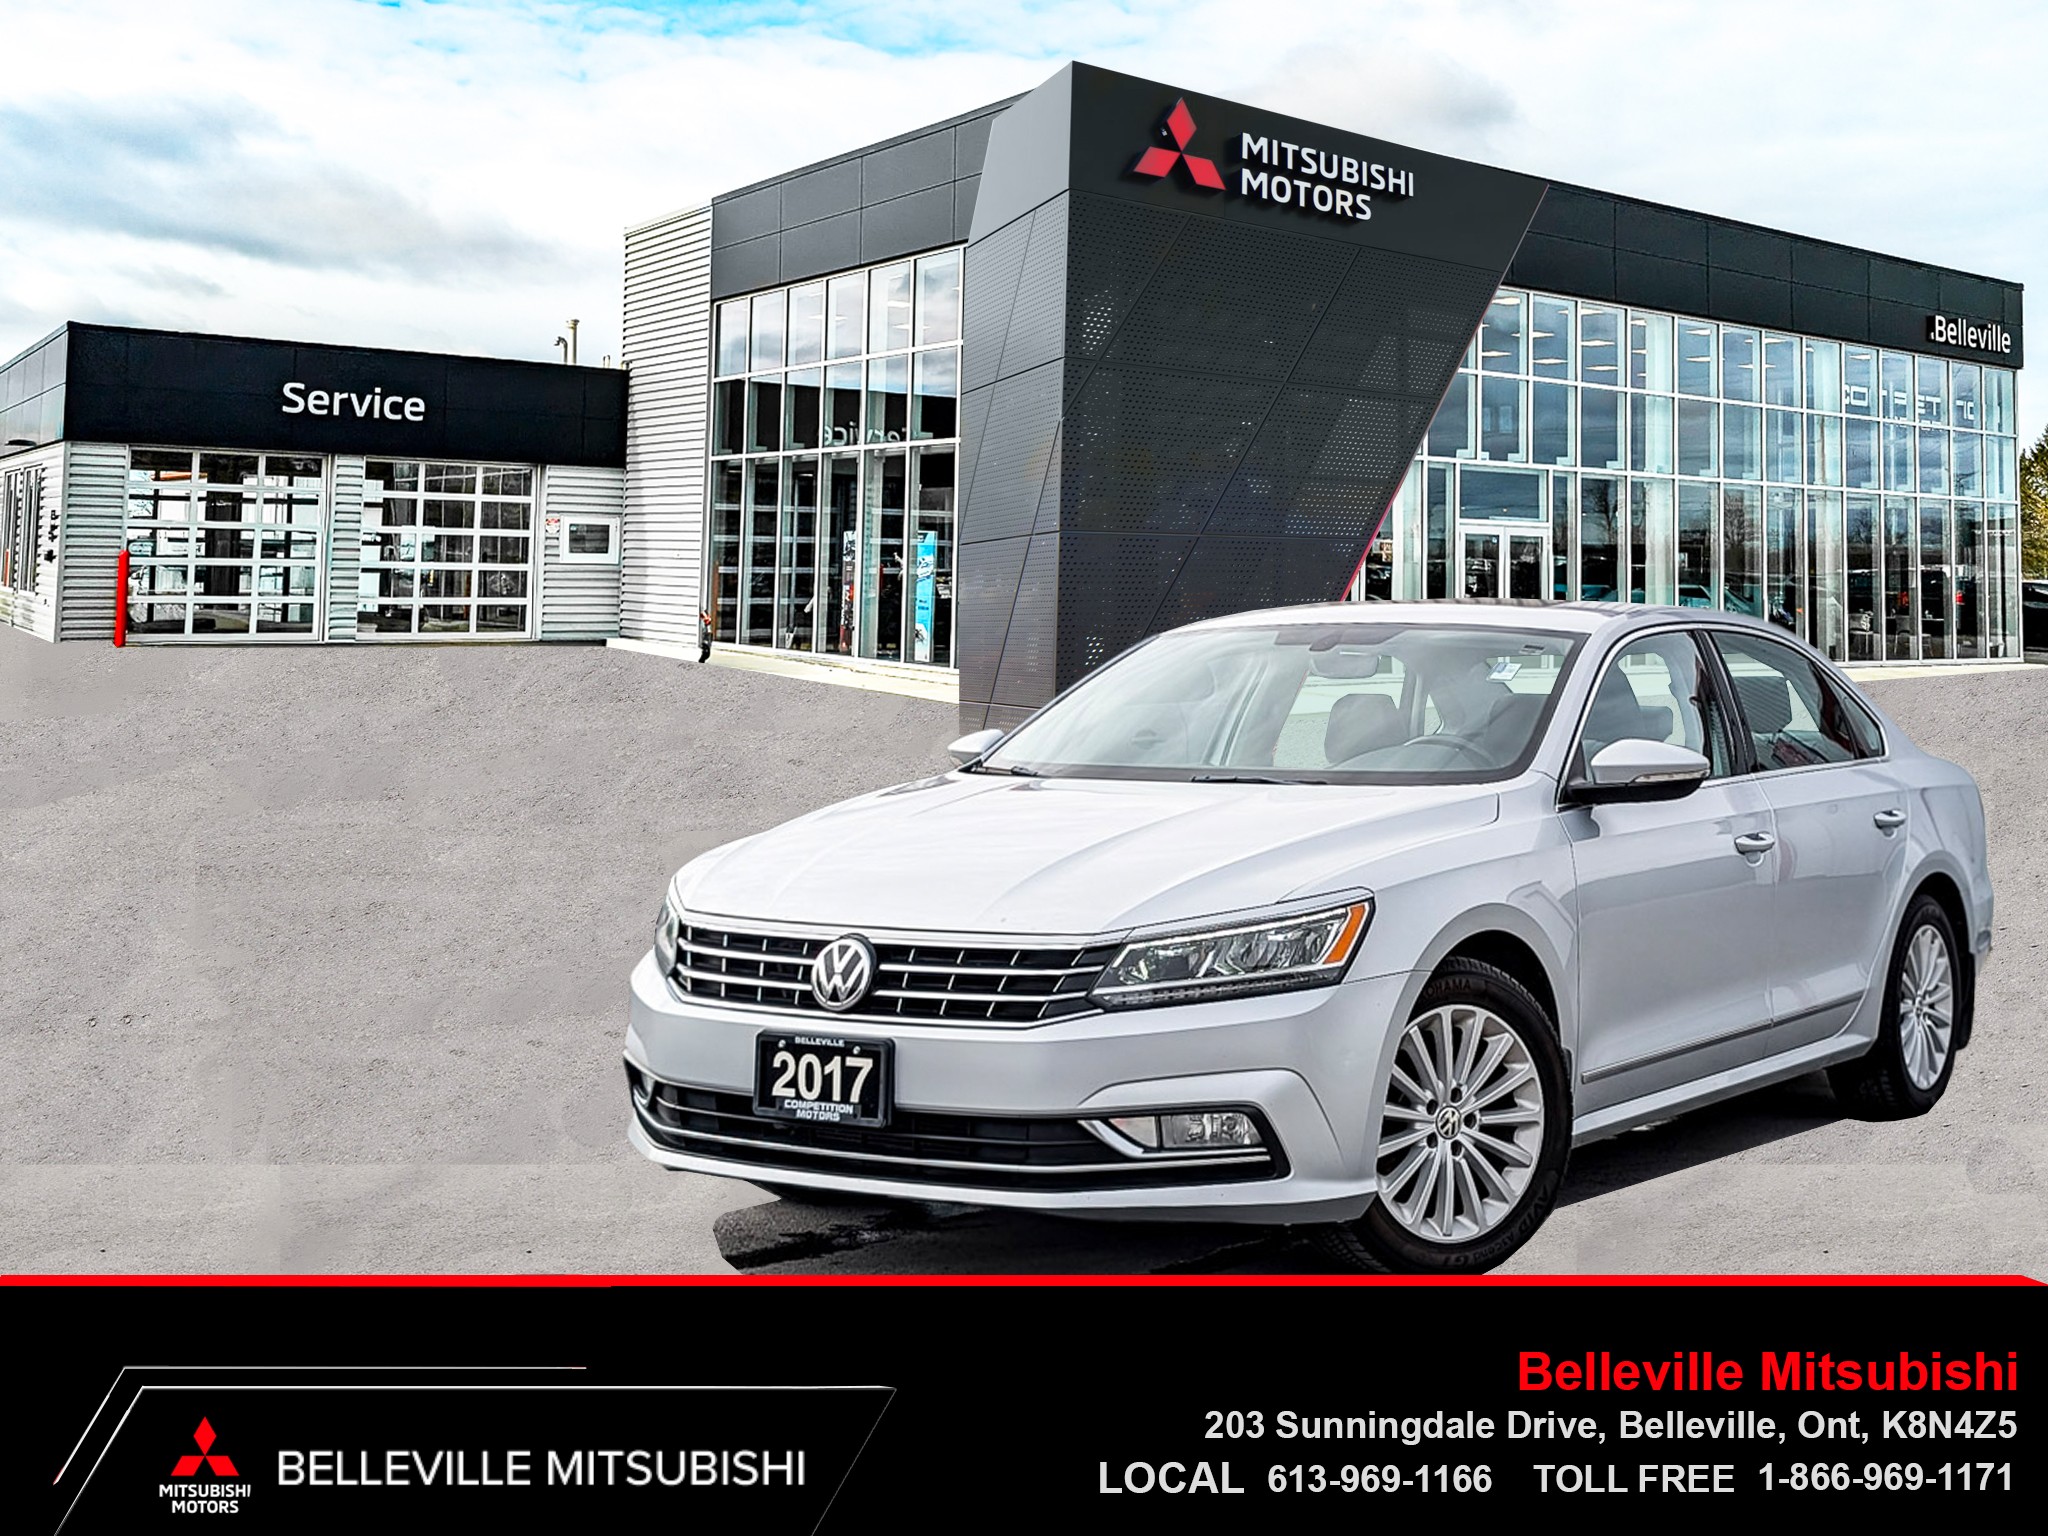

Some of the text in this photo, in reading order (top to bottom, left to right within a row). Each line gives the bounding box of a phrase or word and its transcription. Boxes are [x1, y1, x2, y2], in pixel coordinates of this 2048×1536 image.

[1242, 132, 1414, 197] MITSUBISHI
[1242, 168, 1372, 220] MOTORS
[282, 382, 426, 422] Service
[795, 1036, 845, 1048] BELLEVILLE
[771, 1050, 874, 1104] 2017
[784, 1099, 854, 1115] COMPETITION
[796, 1108, 840, 1122] MOTORS
